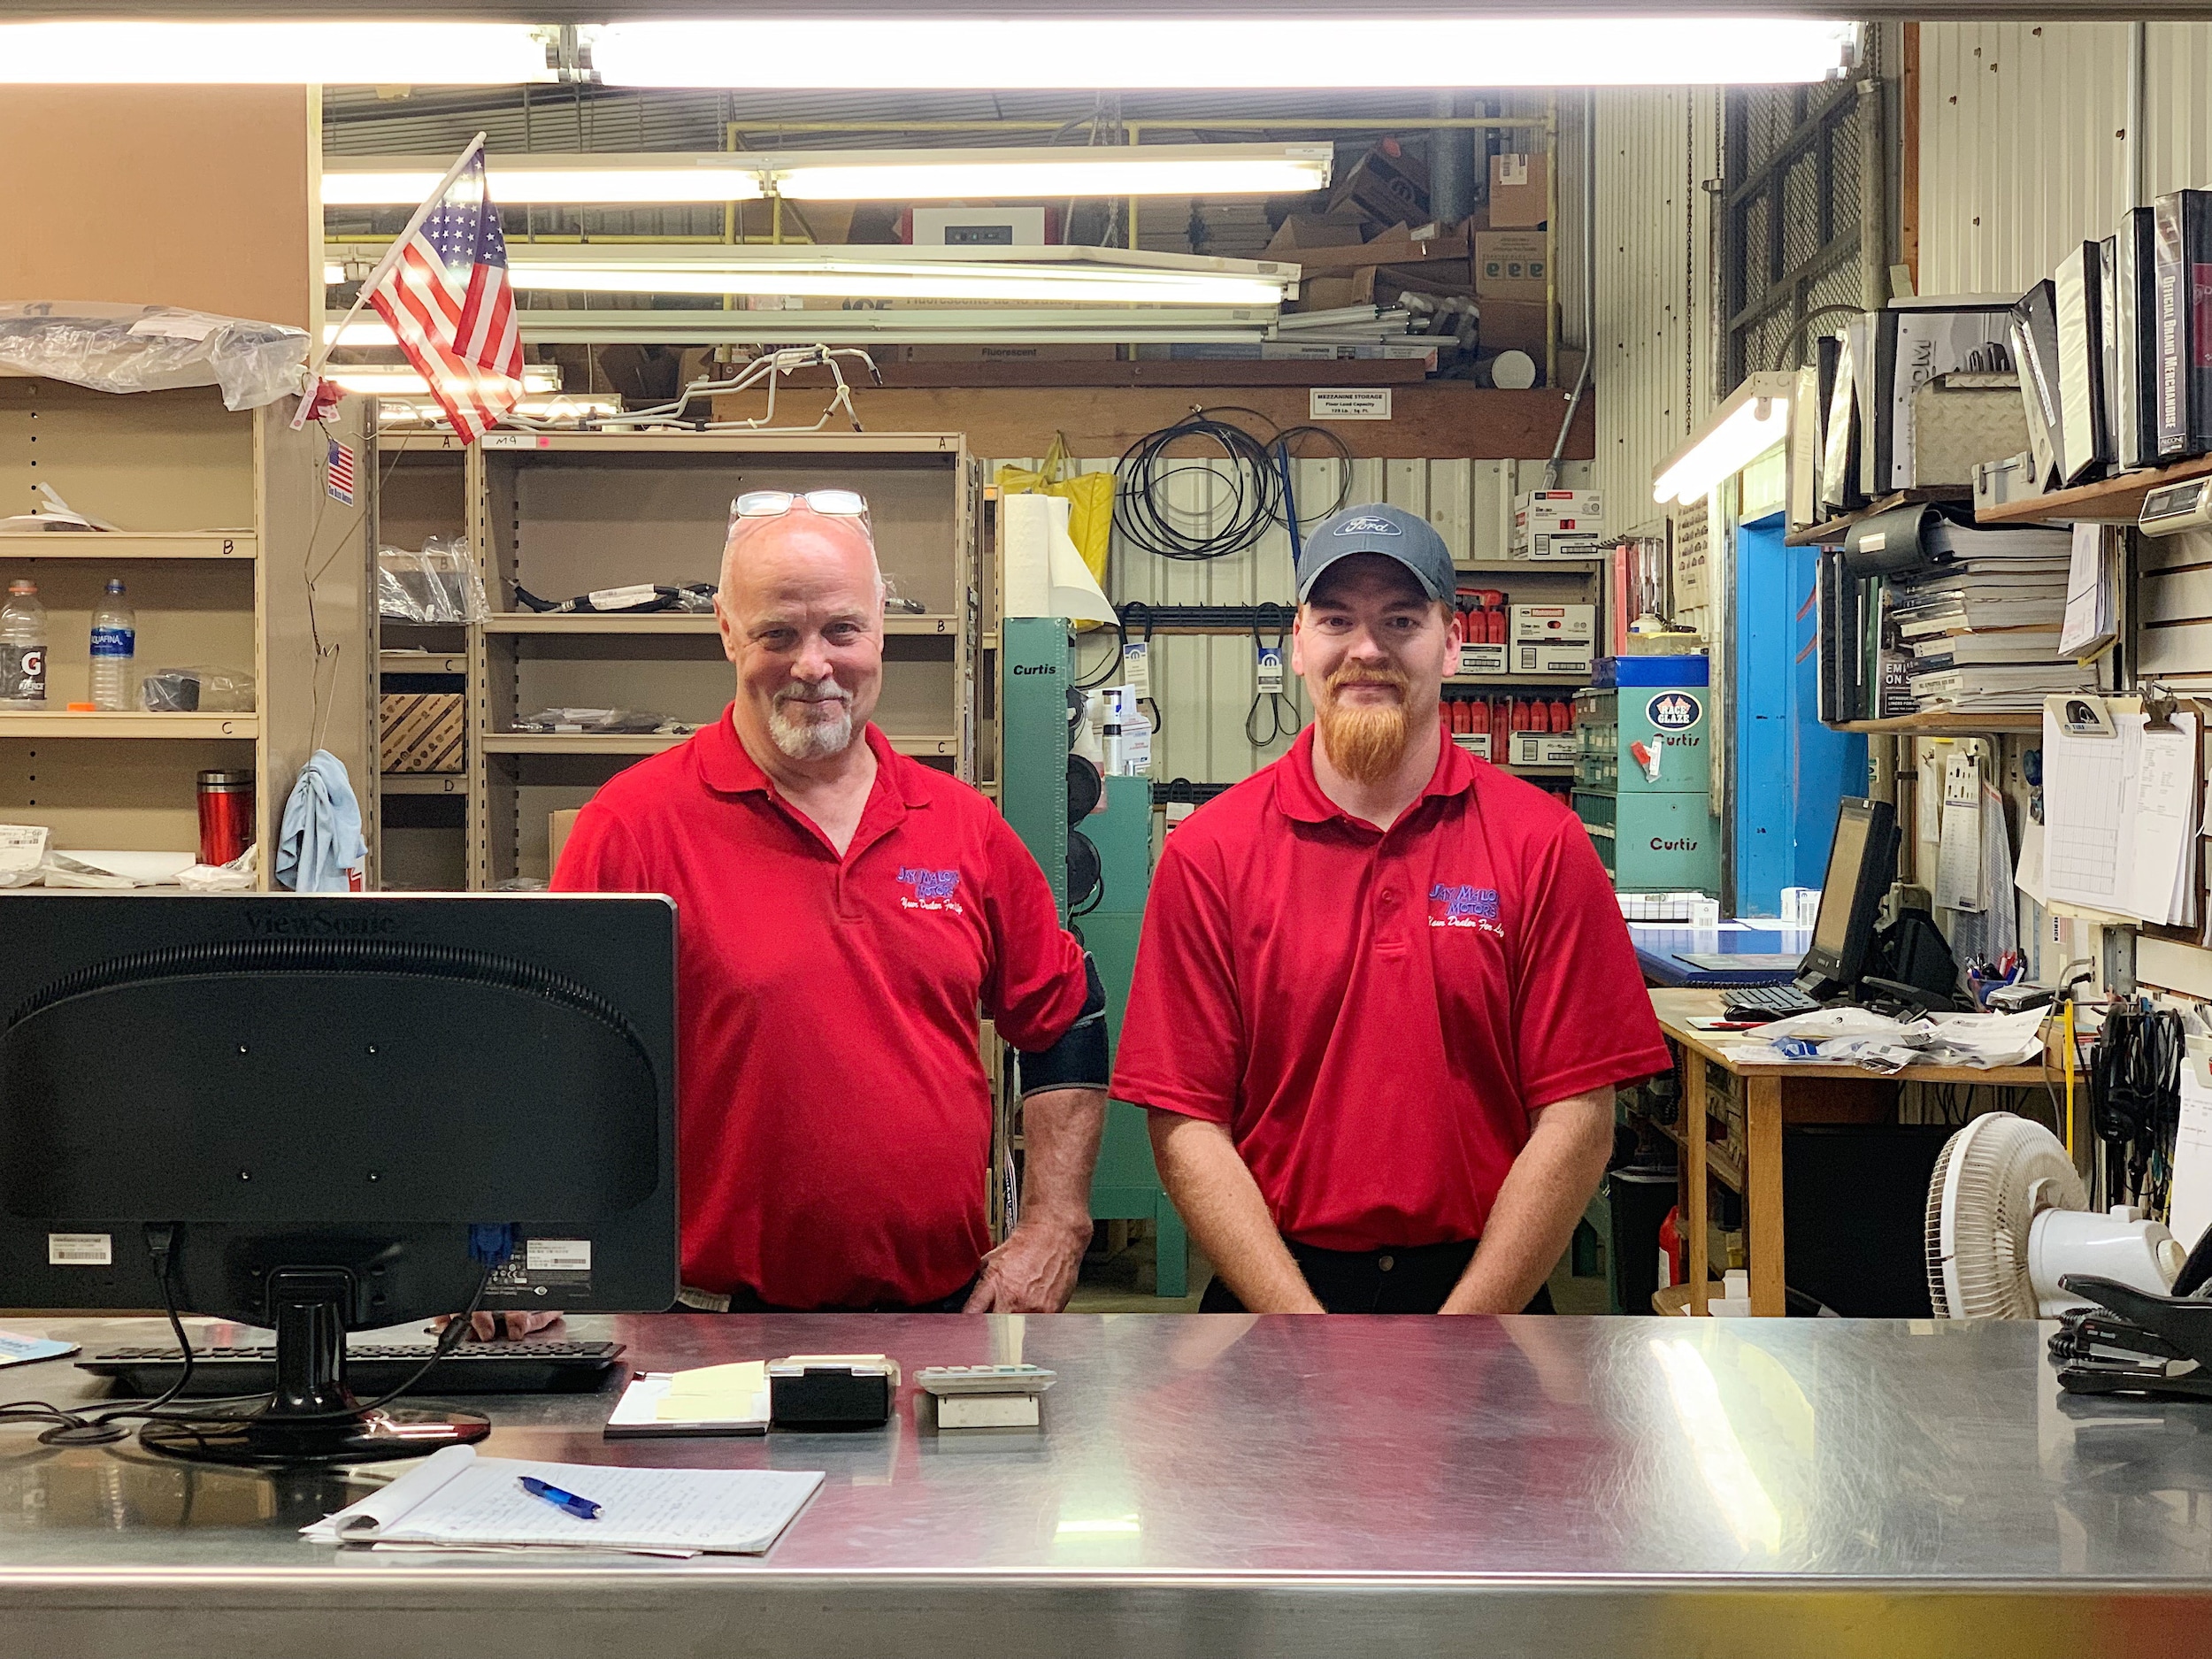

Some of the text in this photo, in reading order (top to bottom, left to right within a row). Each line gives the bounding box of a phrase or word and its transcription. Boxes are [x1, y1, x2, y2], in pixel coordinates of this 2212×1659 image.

[982, 347, 1037, 356] Fluorescent
[2162, 275, 2178, 429] OFFICIAL BRAND MERCHANDISE
[939, 438, 946, 449] A
[1345, 518, 1388, 533] Ford
[223, 540, 234, 554] B
[937, 620, 945, 633] B
[91, 634, 120, 645] AQUAFINA
[21, 651, 42, 676] G
[445, 660, 452, 671] C
[1013, 664, 1056, 675] Curtis
[1886, 674, 1902, 685] ON
[1661, 706, 1687, 715] RACE
[1657, 715, 1690, 724] GLAZE
[222, 722, 232, 734] C
[938, 742, 945, 753] C
[444, 780, 454, 792] D
[1650, 838, 1697, 850] Curtis
[1446, 902, 1497, 918] MOTORS
